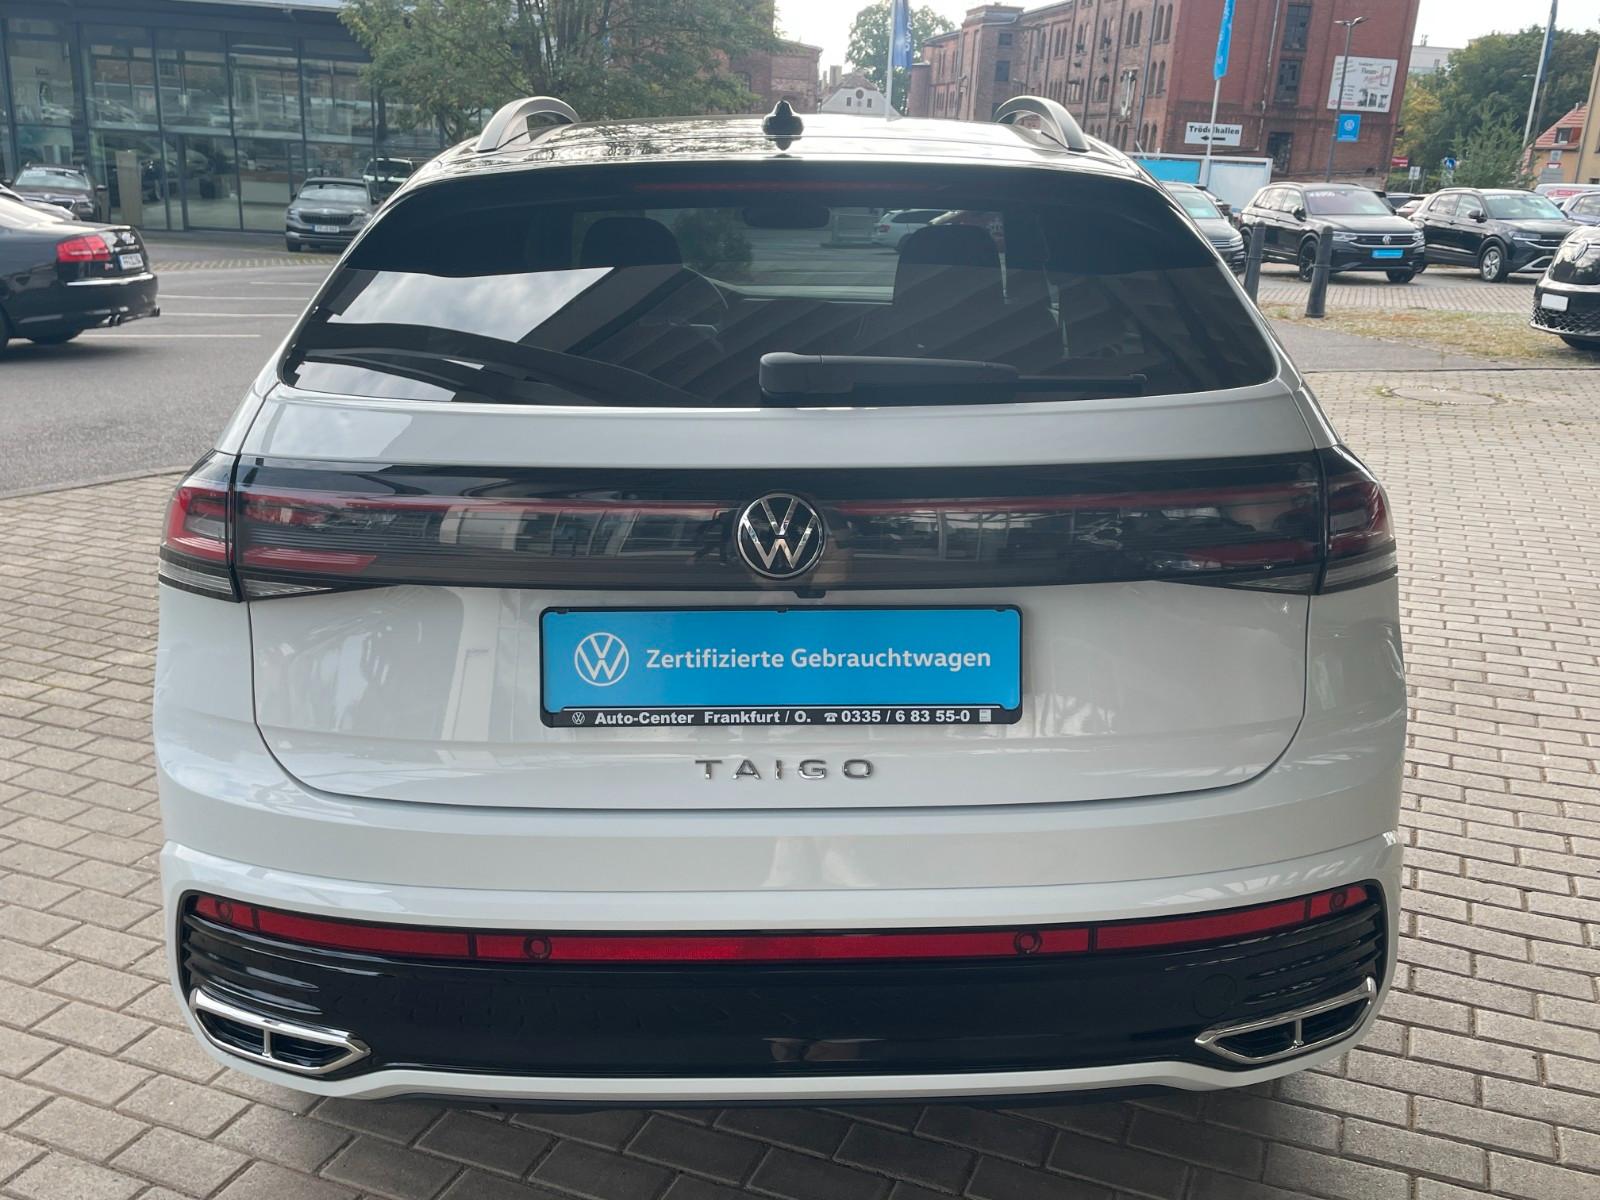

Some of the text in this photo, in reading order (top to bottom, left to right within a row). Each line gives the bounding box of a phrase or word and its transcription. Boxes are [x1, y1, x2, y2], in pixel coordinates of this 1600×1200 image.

[1189, 125, 1240, 135] Trödhallen
[574, 632, 630, 687] VW
[646, 647, 991, 672] Zertifizierte Gebrauchtwagen
[594, 712, 694, 725] Auto-Center
[704, 711, 781, 724] Frankfurt
[841, 709, 881, 723] 0335
[910, 709, 931, 723] 83
[935, 709, 971, 722] 55-0
[695, 759, 874, 780] TAIGO
